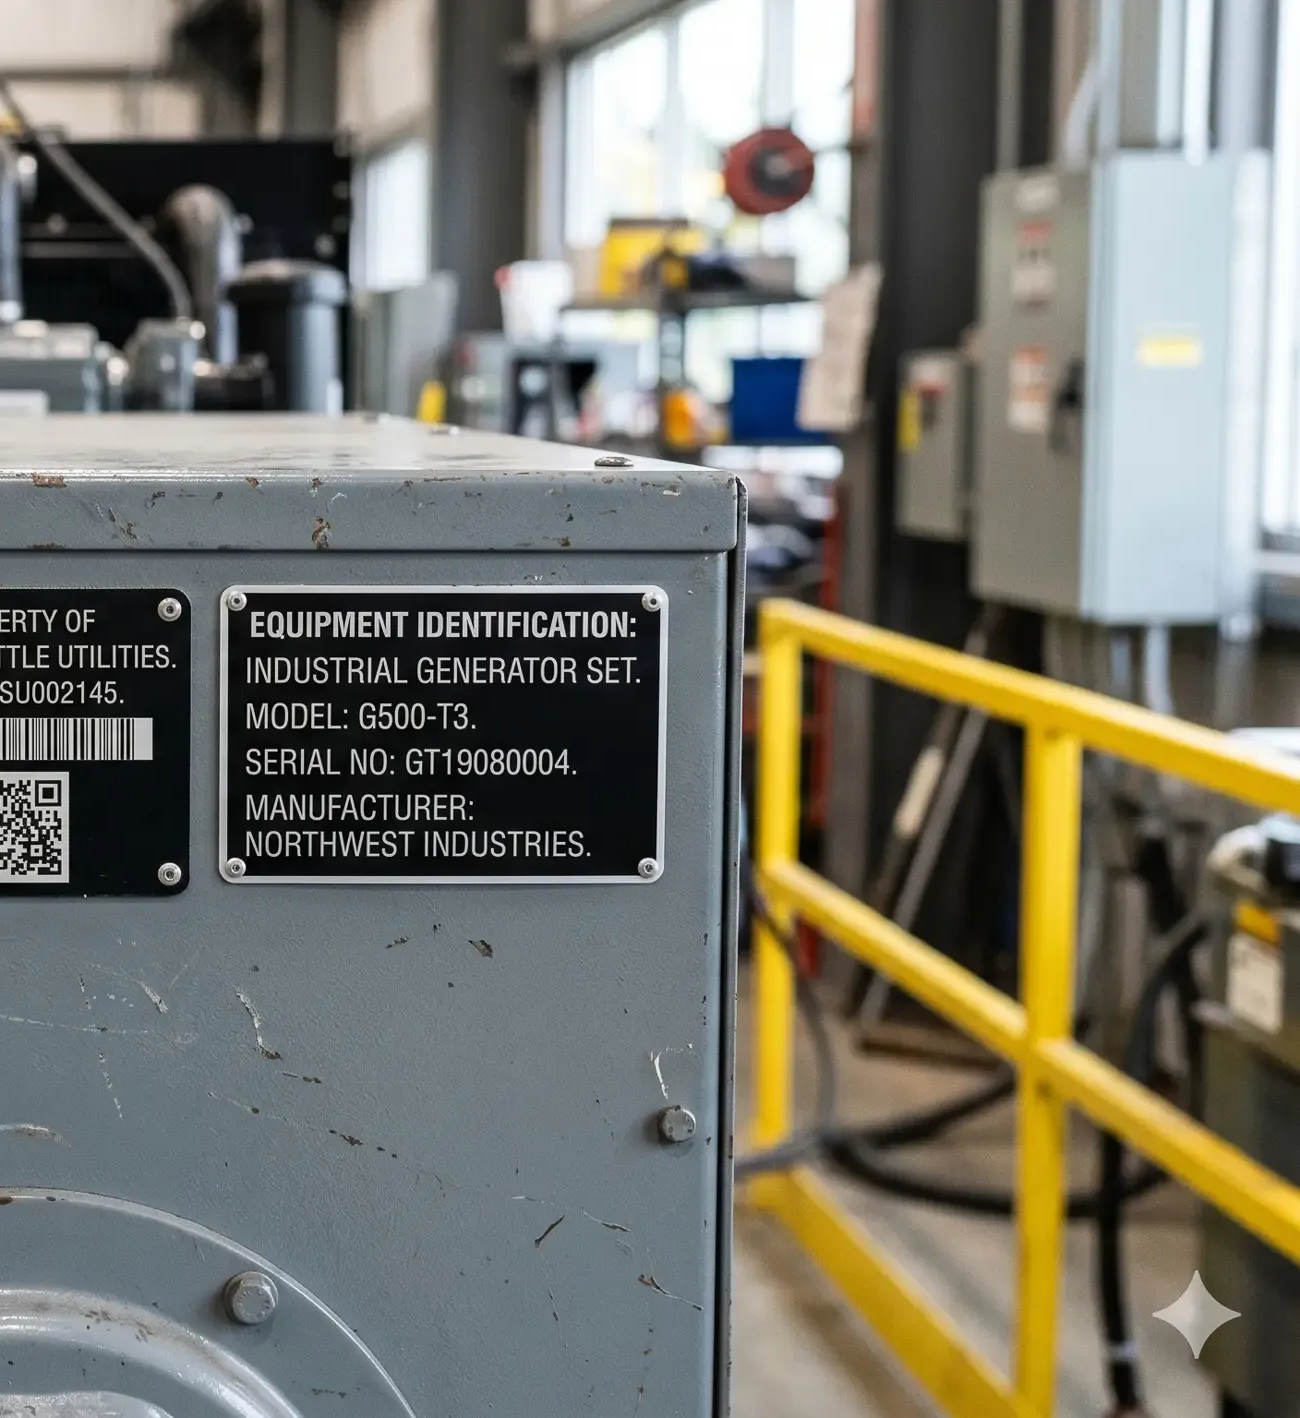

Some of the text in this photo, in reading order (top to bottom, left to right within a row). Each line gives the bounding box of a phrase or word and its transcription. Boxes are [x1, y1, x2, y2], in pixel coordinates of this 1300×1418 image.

[66, 609, 95, 632] OF
[251, 611, 636, 639] EQUIPMENT IDENTIFICATION:
[59, 645, 176, 668] UTILITIES.
[247, 657, 640, 683] INDUSTRIAL GENERATOR SET.
[247, 703, 475, 729] MODEL: G500-T3.
[246, 749, 576, 775] SERIAL NO: GT19080004.
[247, 794, 473, 820] MANUFACTURER:
[246, 831, 590, 857] NORTHWEST INDUSTRIES.
